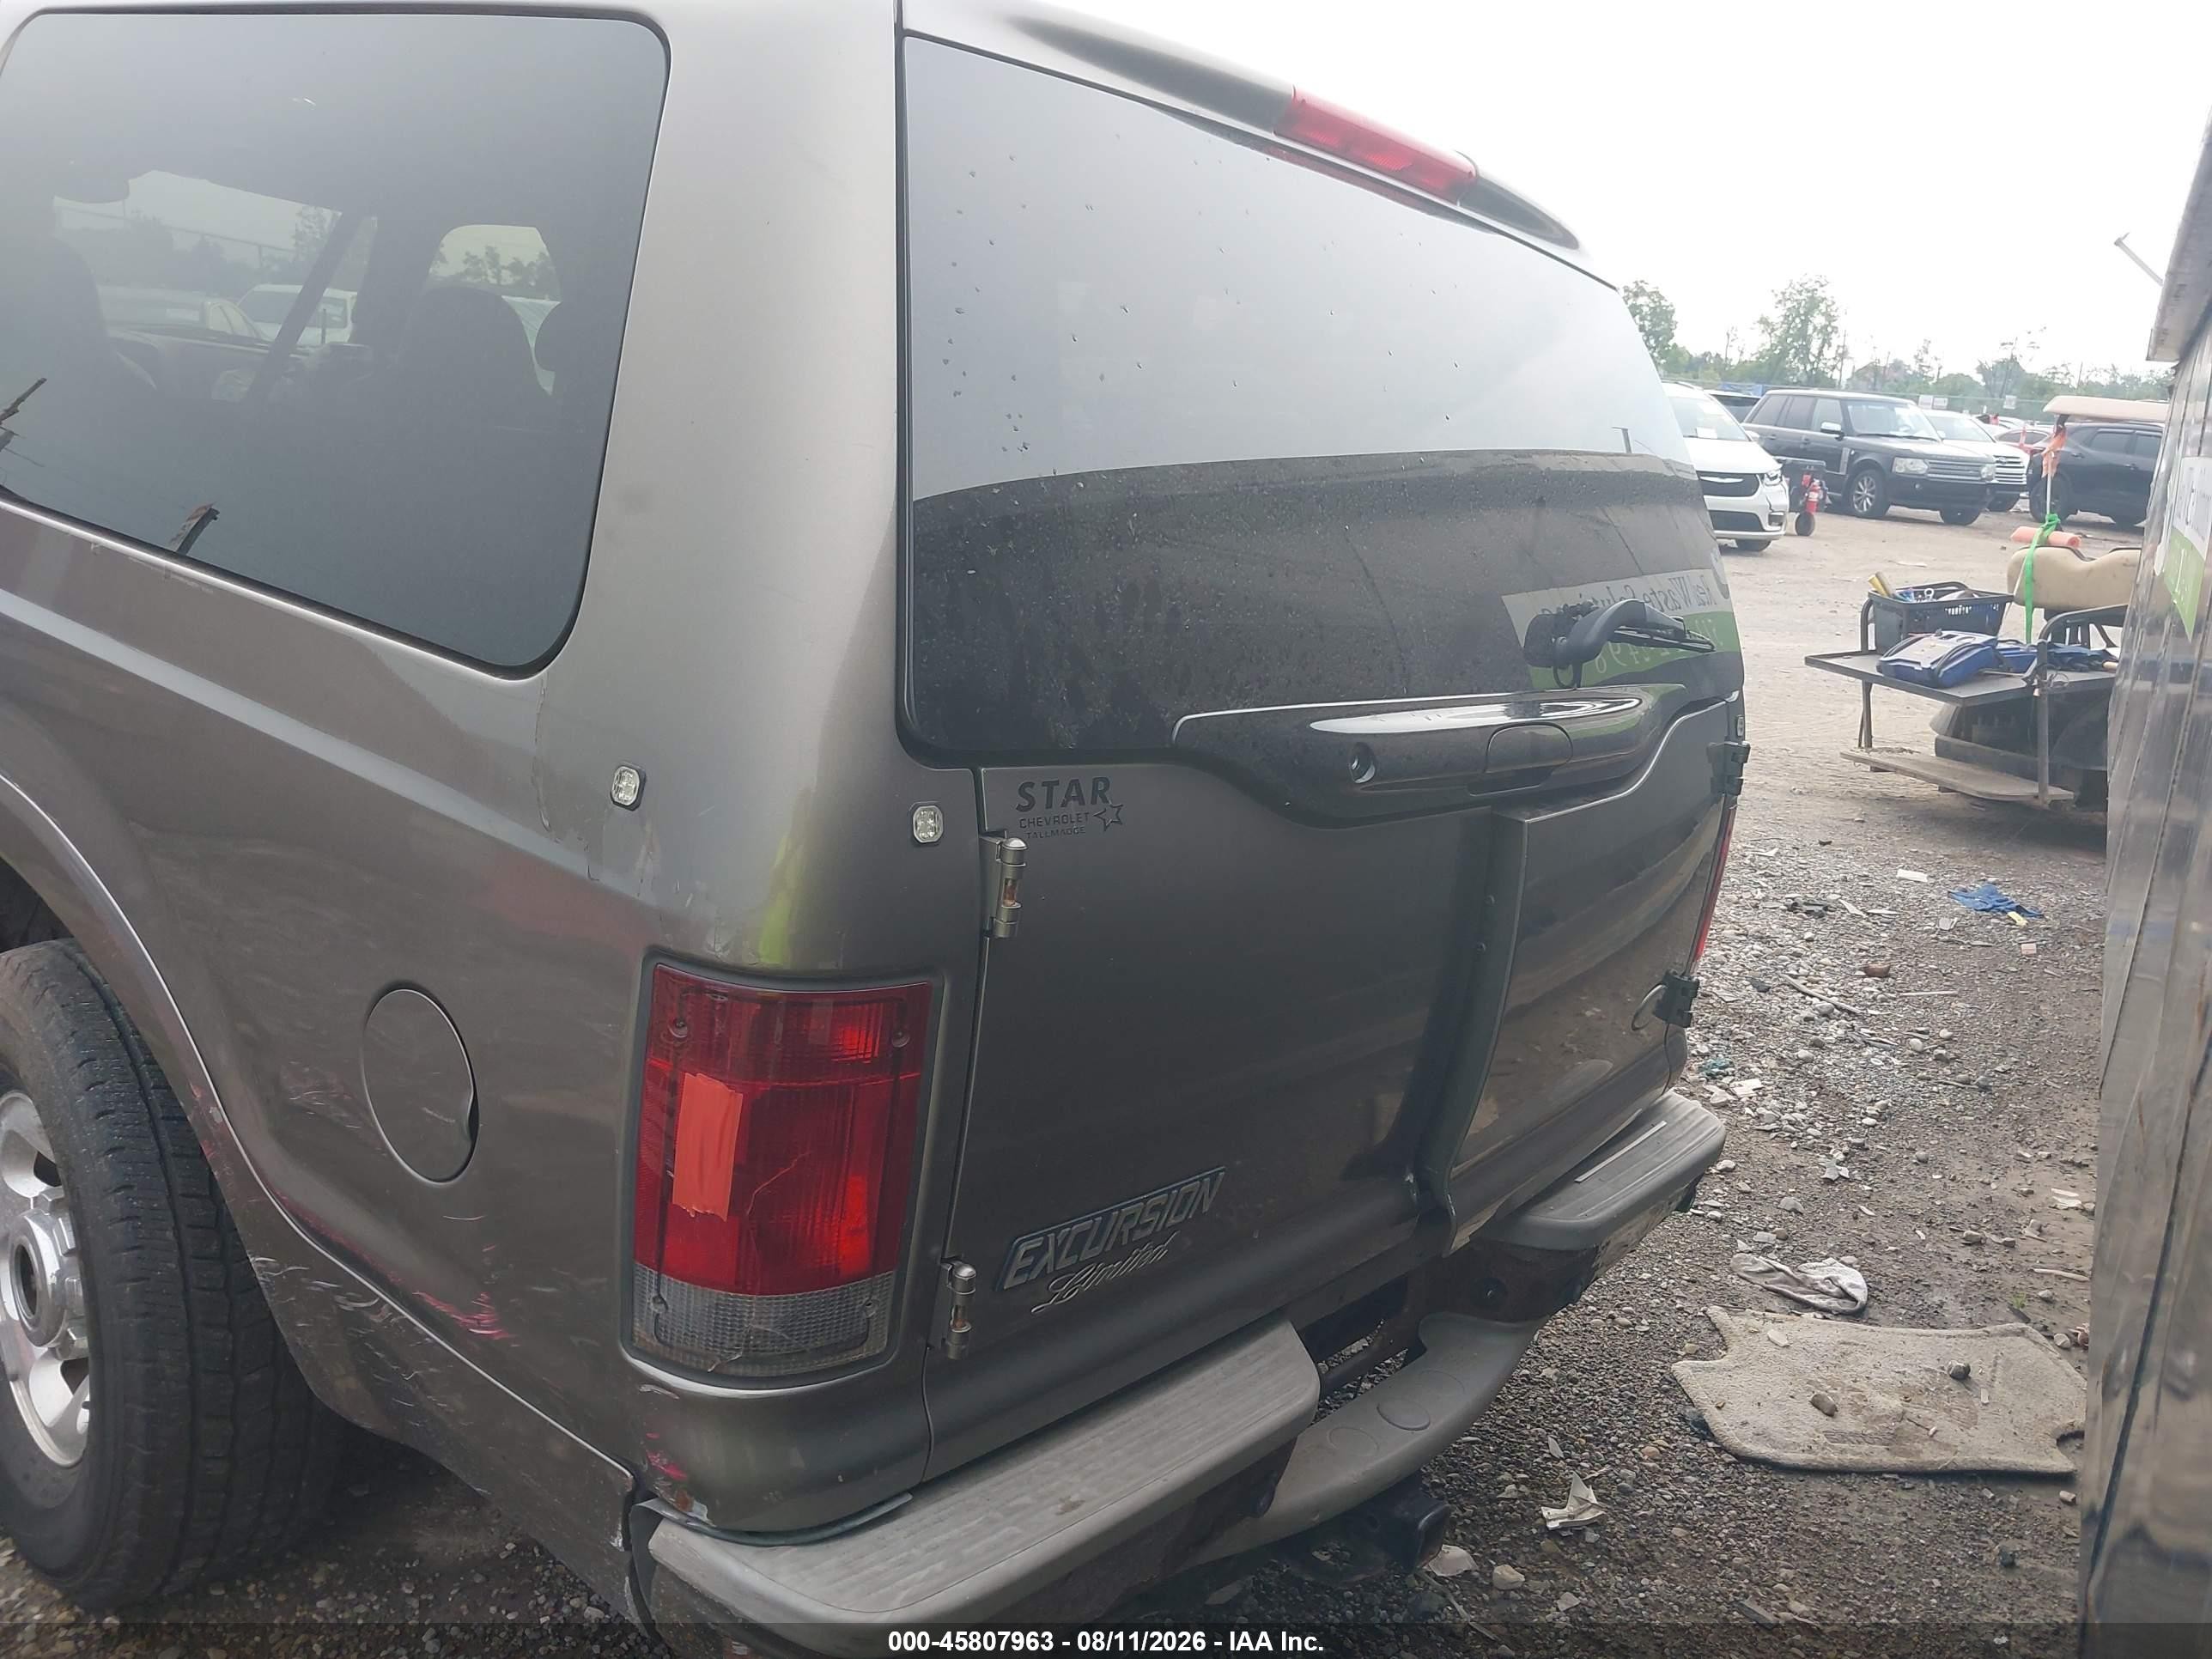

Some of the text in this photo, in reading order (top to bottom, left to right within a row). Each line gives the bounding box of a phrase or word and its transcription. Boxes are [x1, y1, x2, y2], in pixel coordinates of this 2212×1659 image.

[1016, 776, 1111, 812] STAR
[1019, 811, 1090, 829] CHEVROLET
[1025, 826, 1086, 839] TALLMADGE
[1003, 1171, 1226, 1291] EXCURSION
